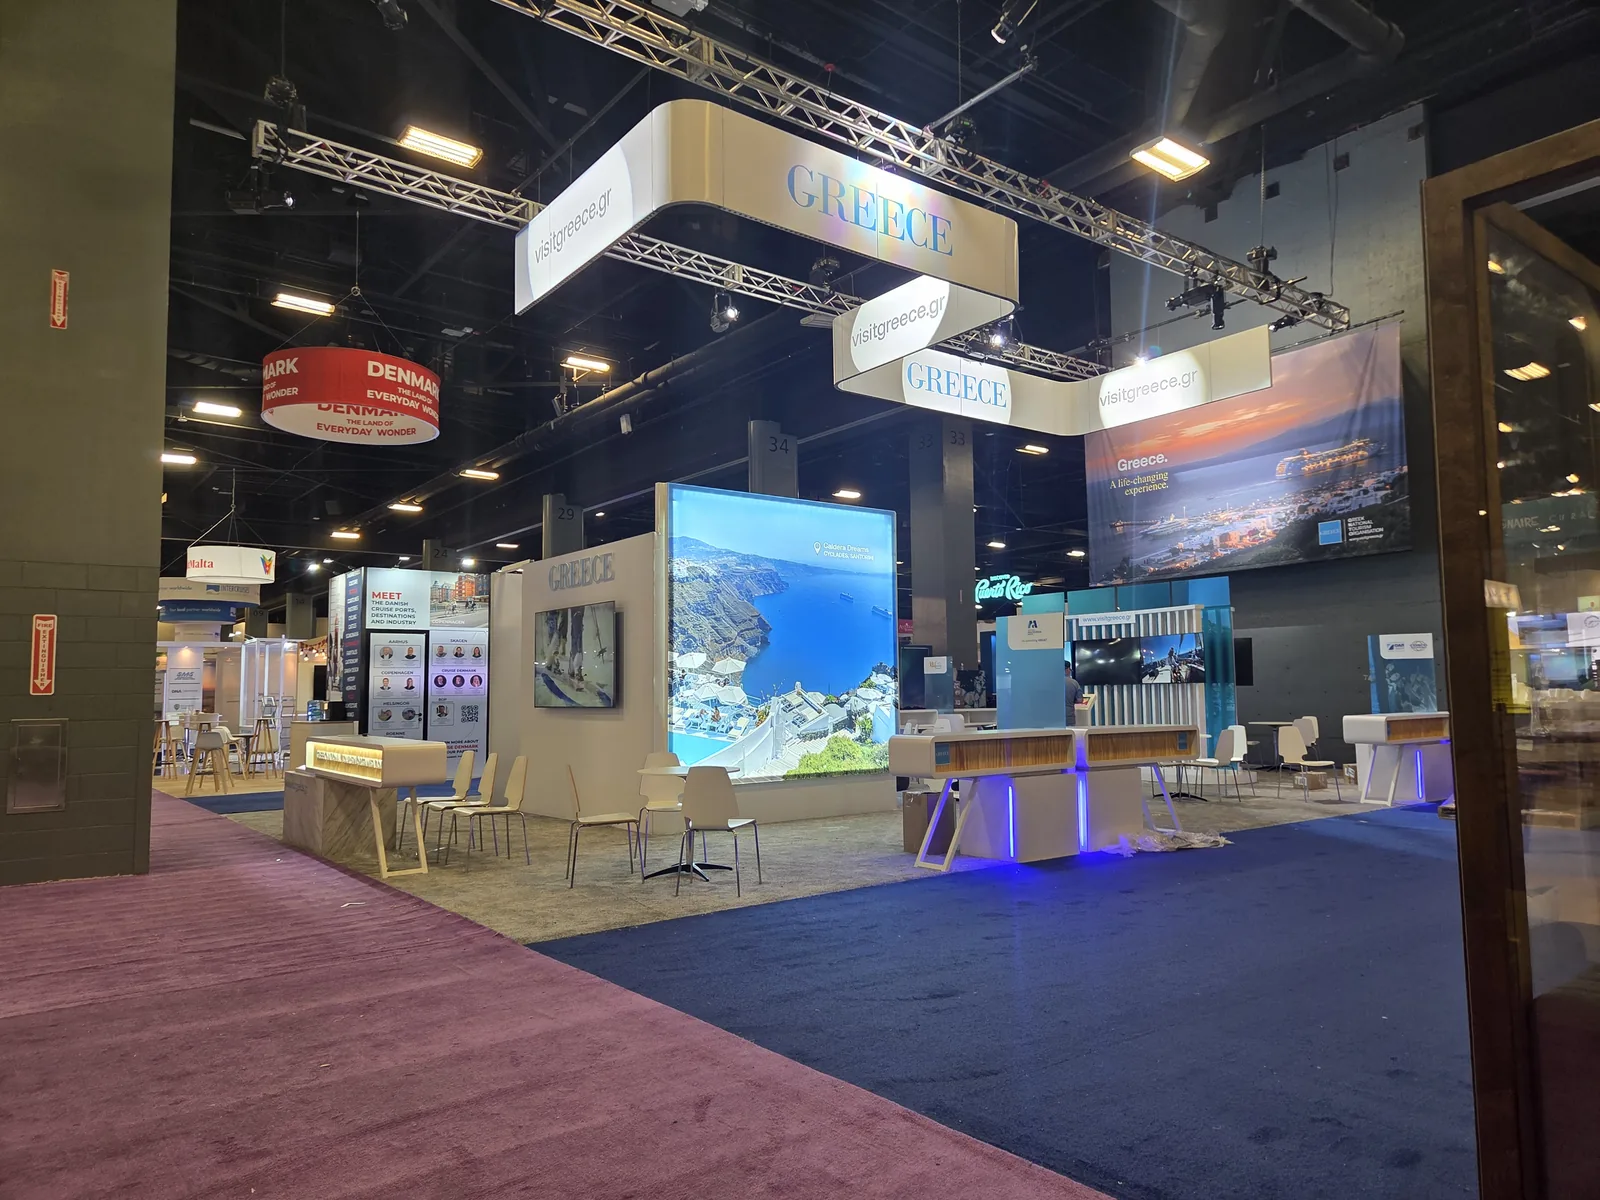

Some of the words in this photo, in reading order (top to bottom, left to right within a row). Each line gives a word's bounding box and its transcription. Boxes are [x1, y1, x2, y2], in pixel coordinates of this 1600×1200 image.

[787, 164, 953, 257] GREECE
[534, 187, 612, 264] visitgreece.gr
[851, 295, 946, 348] visitgreece.gr
[265, 387, 299, 401] WONDER
[397, 386, 411, 396] THE
[411, 391, 427, 402] LAND
[907, 361, 1007, 408] GREECE
[1099, 369, 1198, 407] visitgreece.gr
[366, 389, 420, 410] EVERYDAY
[316, 423, 373, 436] EVERYDAY
[377, 427, 417, 437] WONDER
[346, 418, 362, 426] THE
[768, 435, 790, 455] 34
[950, 430, 966, 446] 33
[1117, 453, 1168, 472] Greece.
[1109, 480, 1118, 490] A
[1117, 471, 1169, 488] life-changing
[1124, 481, 1169, 497] experience.
[557, 506, 575, 521] 29
[433, 548, 448, 558] 24
[823, 541, 846, 551] Caldera
[846, 544, 870, 553] Dreams
[548, 552, 615, 592] GREECE
[371, 591, 402, 600] MEET
[974, 578, 1006, 604] Puerto
[1005, 575, 1033, 600] Rico
[253, 609, 263, 617] 09
[40, 629, 48, 687] EXTINGUISHER
